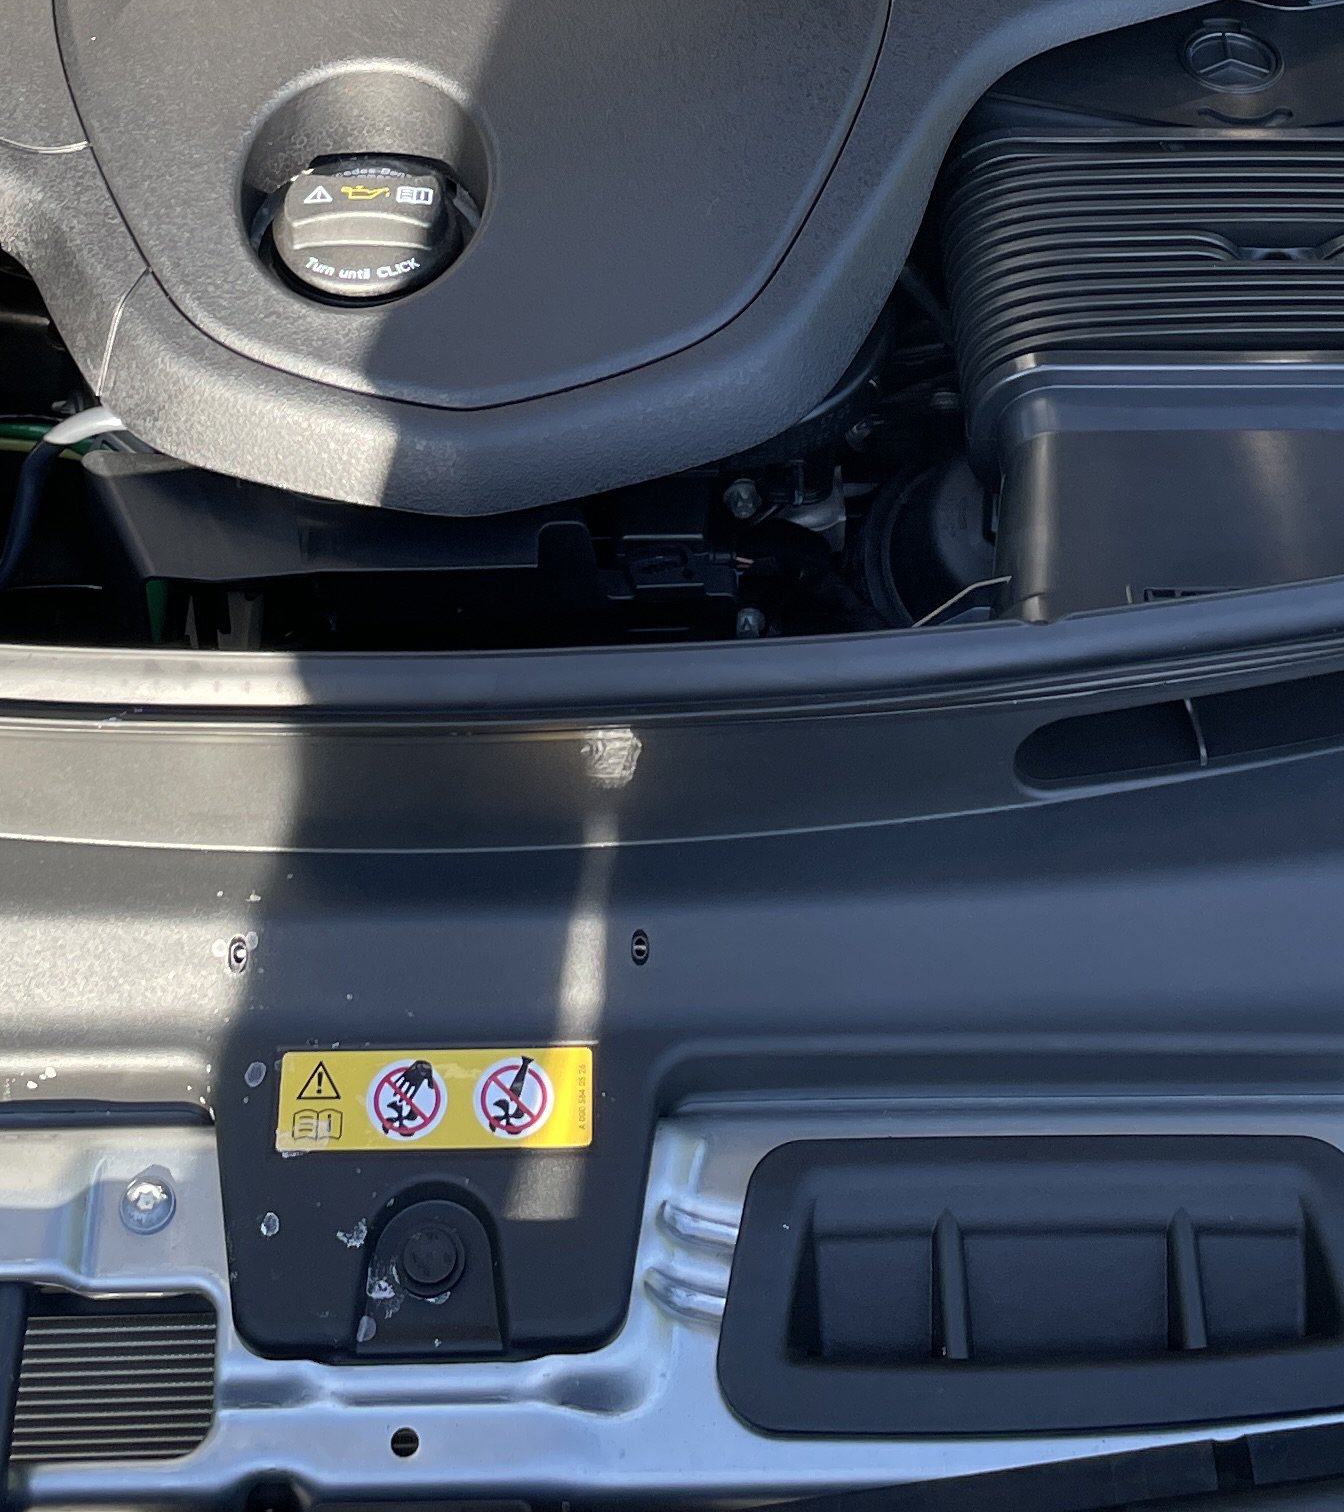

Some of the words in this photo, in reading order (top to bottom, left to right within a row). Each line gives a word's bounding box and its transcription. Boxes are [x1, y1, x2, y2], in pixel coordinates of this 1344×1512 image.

[306, 257, 335, 277] Turn
[339, 267, 371, 280] until
[376, 257, 421, 278] CLICK
